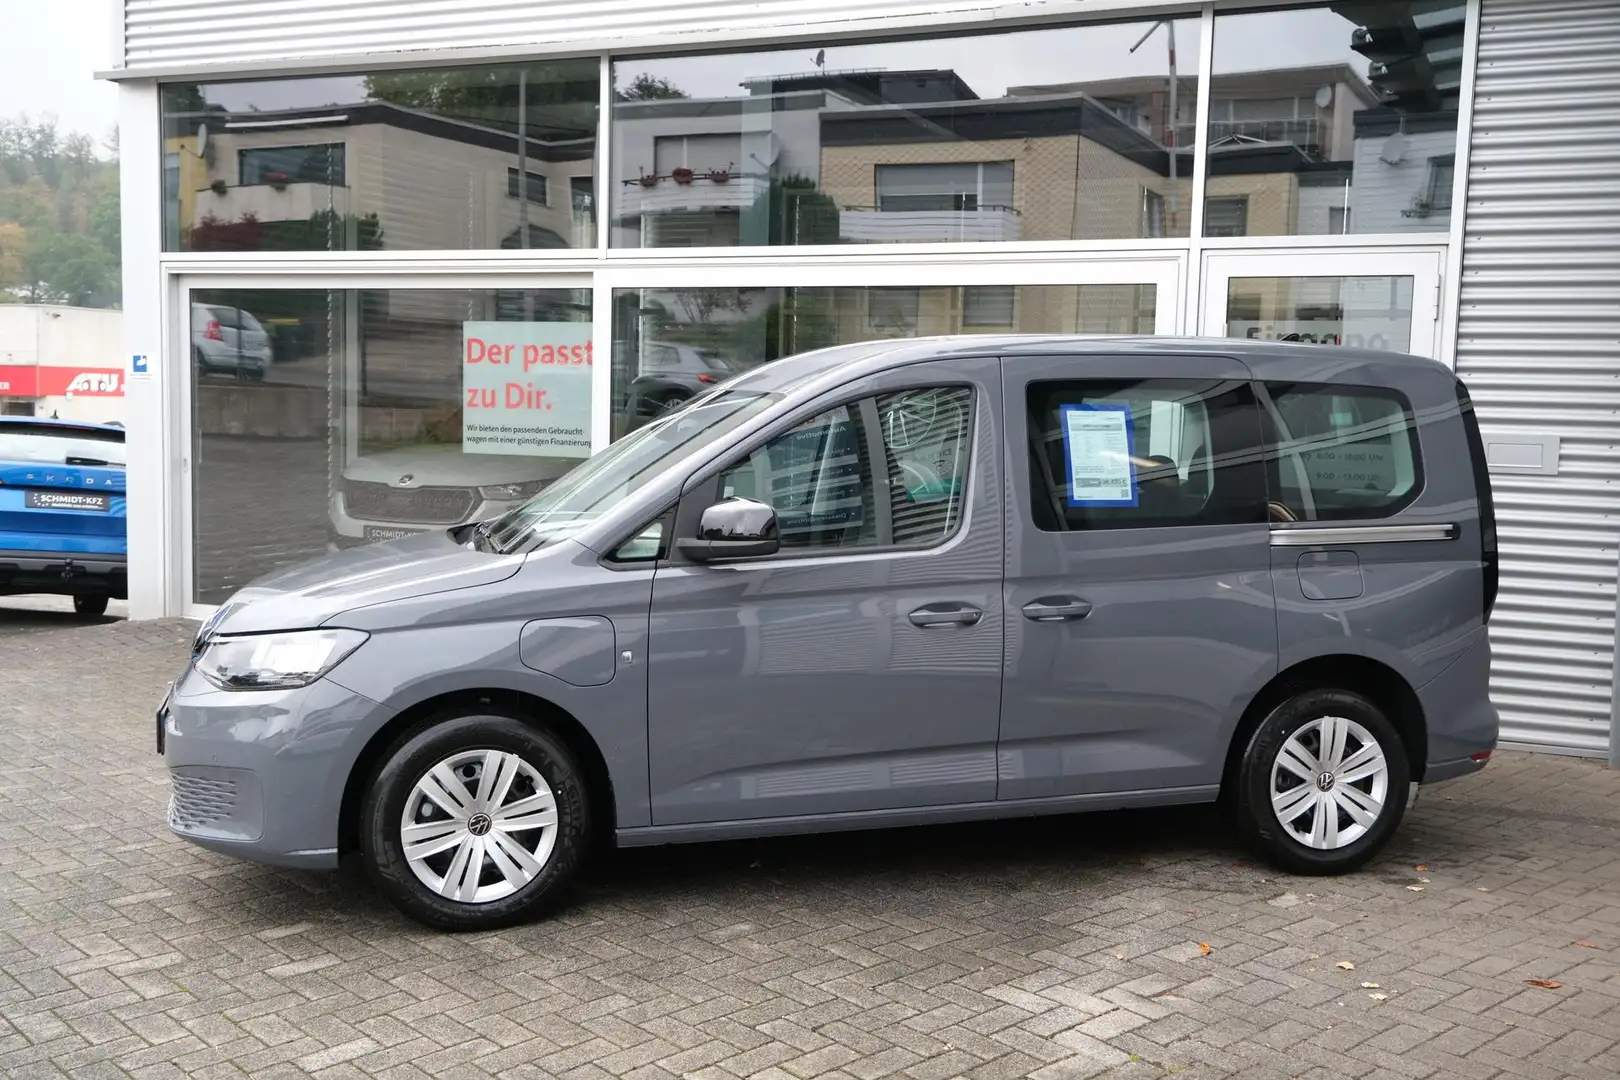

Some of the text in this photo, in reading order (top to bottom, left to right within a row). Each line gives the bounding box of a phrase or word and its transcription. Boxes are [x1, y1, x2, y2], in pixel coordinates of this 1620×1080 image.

[466, 337, 593, 373] Der passt
[467, 382, 552, 410] zu Dir.
[466, 424, 585, 436] Wir bieten den passenden Gebraucht-
[466, 436, 487, 444] wagen
[517, 437, 549, 446] günstigen
[40, 494, 104, 505] SCHMIDT-KFZ
[371, 529, 416, 539] SCHMIDT-K
